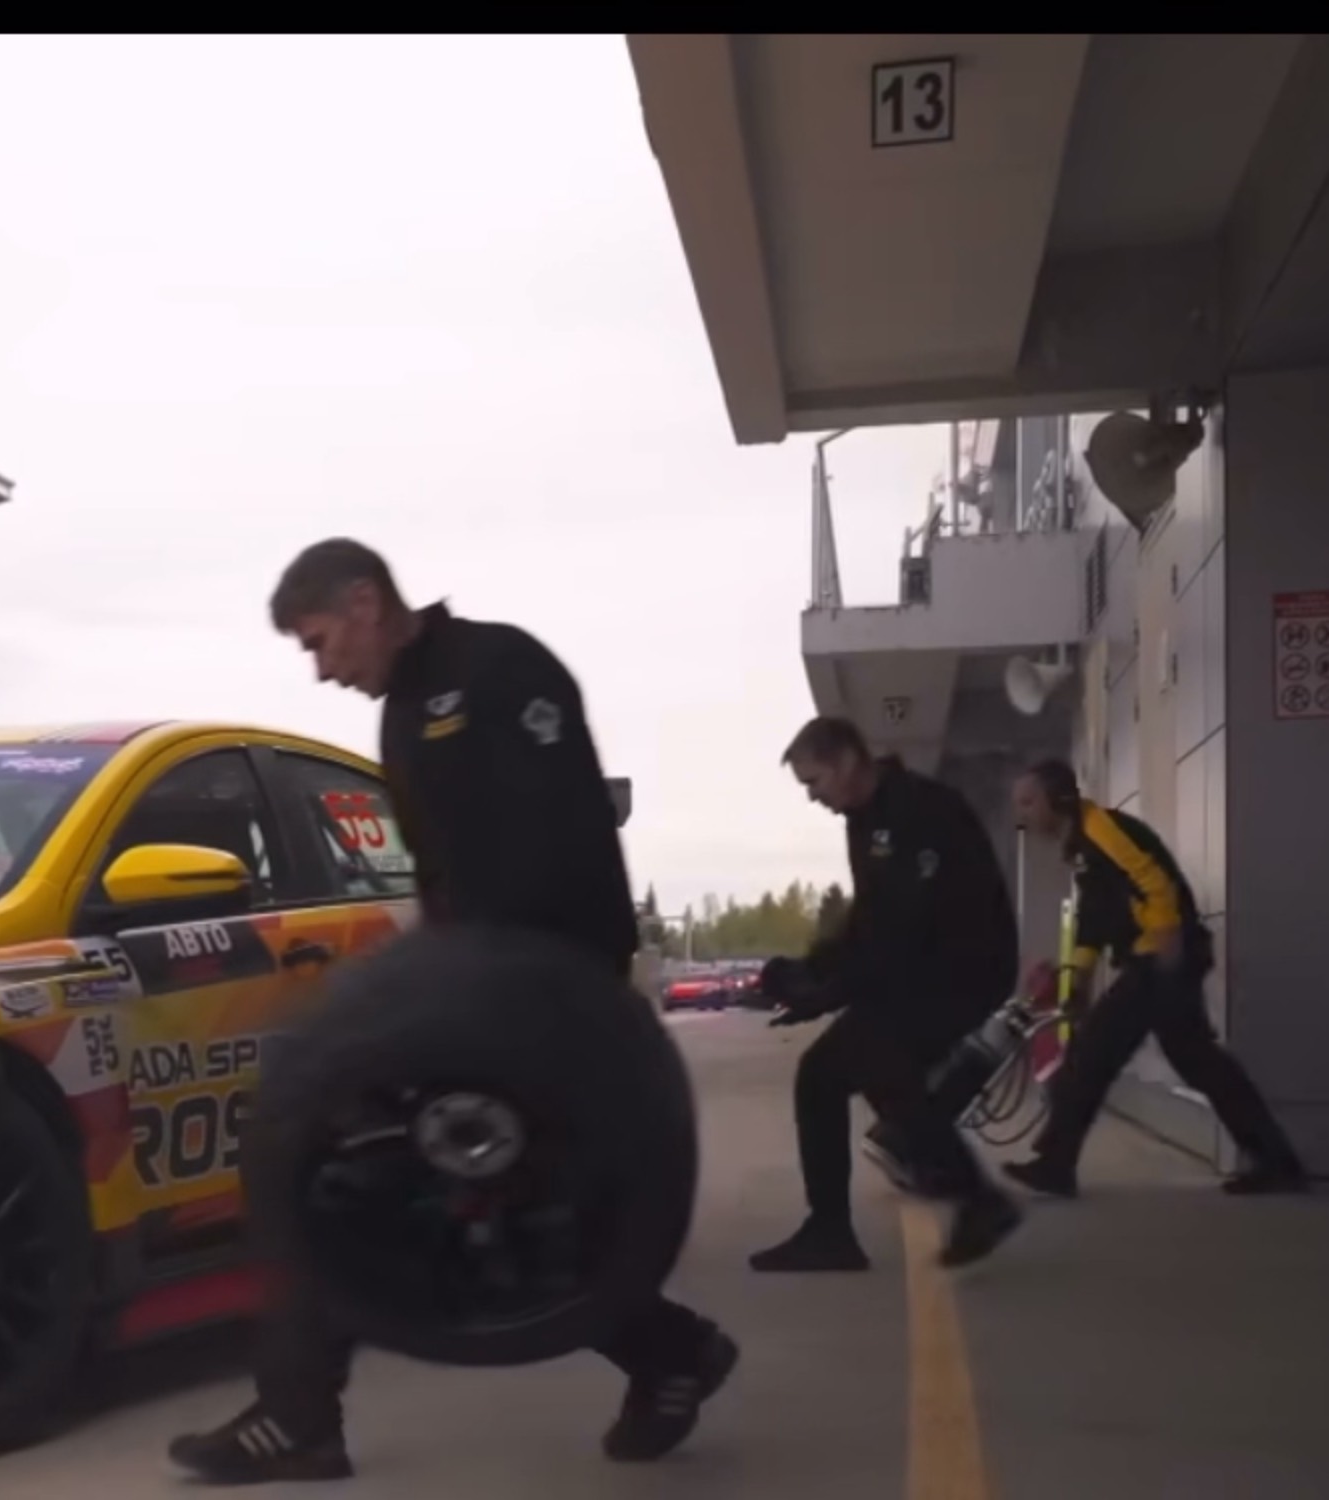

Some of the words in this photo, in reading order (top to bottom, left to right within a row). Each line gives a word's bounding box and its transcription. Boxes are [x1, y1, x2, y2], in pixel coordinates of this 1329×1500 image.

[879, 72, 945, 134] 13
[324, 791, 387, 849] 55
[128, 1042, 195, 1089] ADA
[206, 1039, 259, 1077] SP
[130, 1090, 242, 1186] ROS
